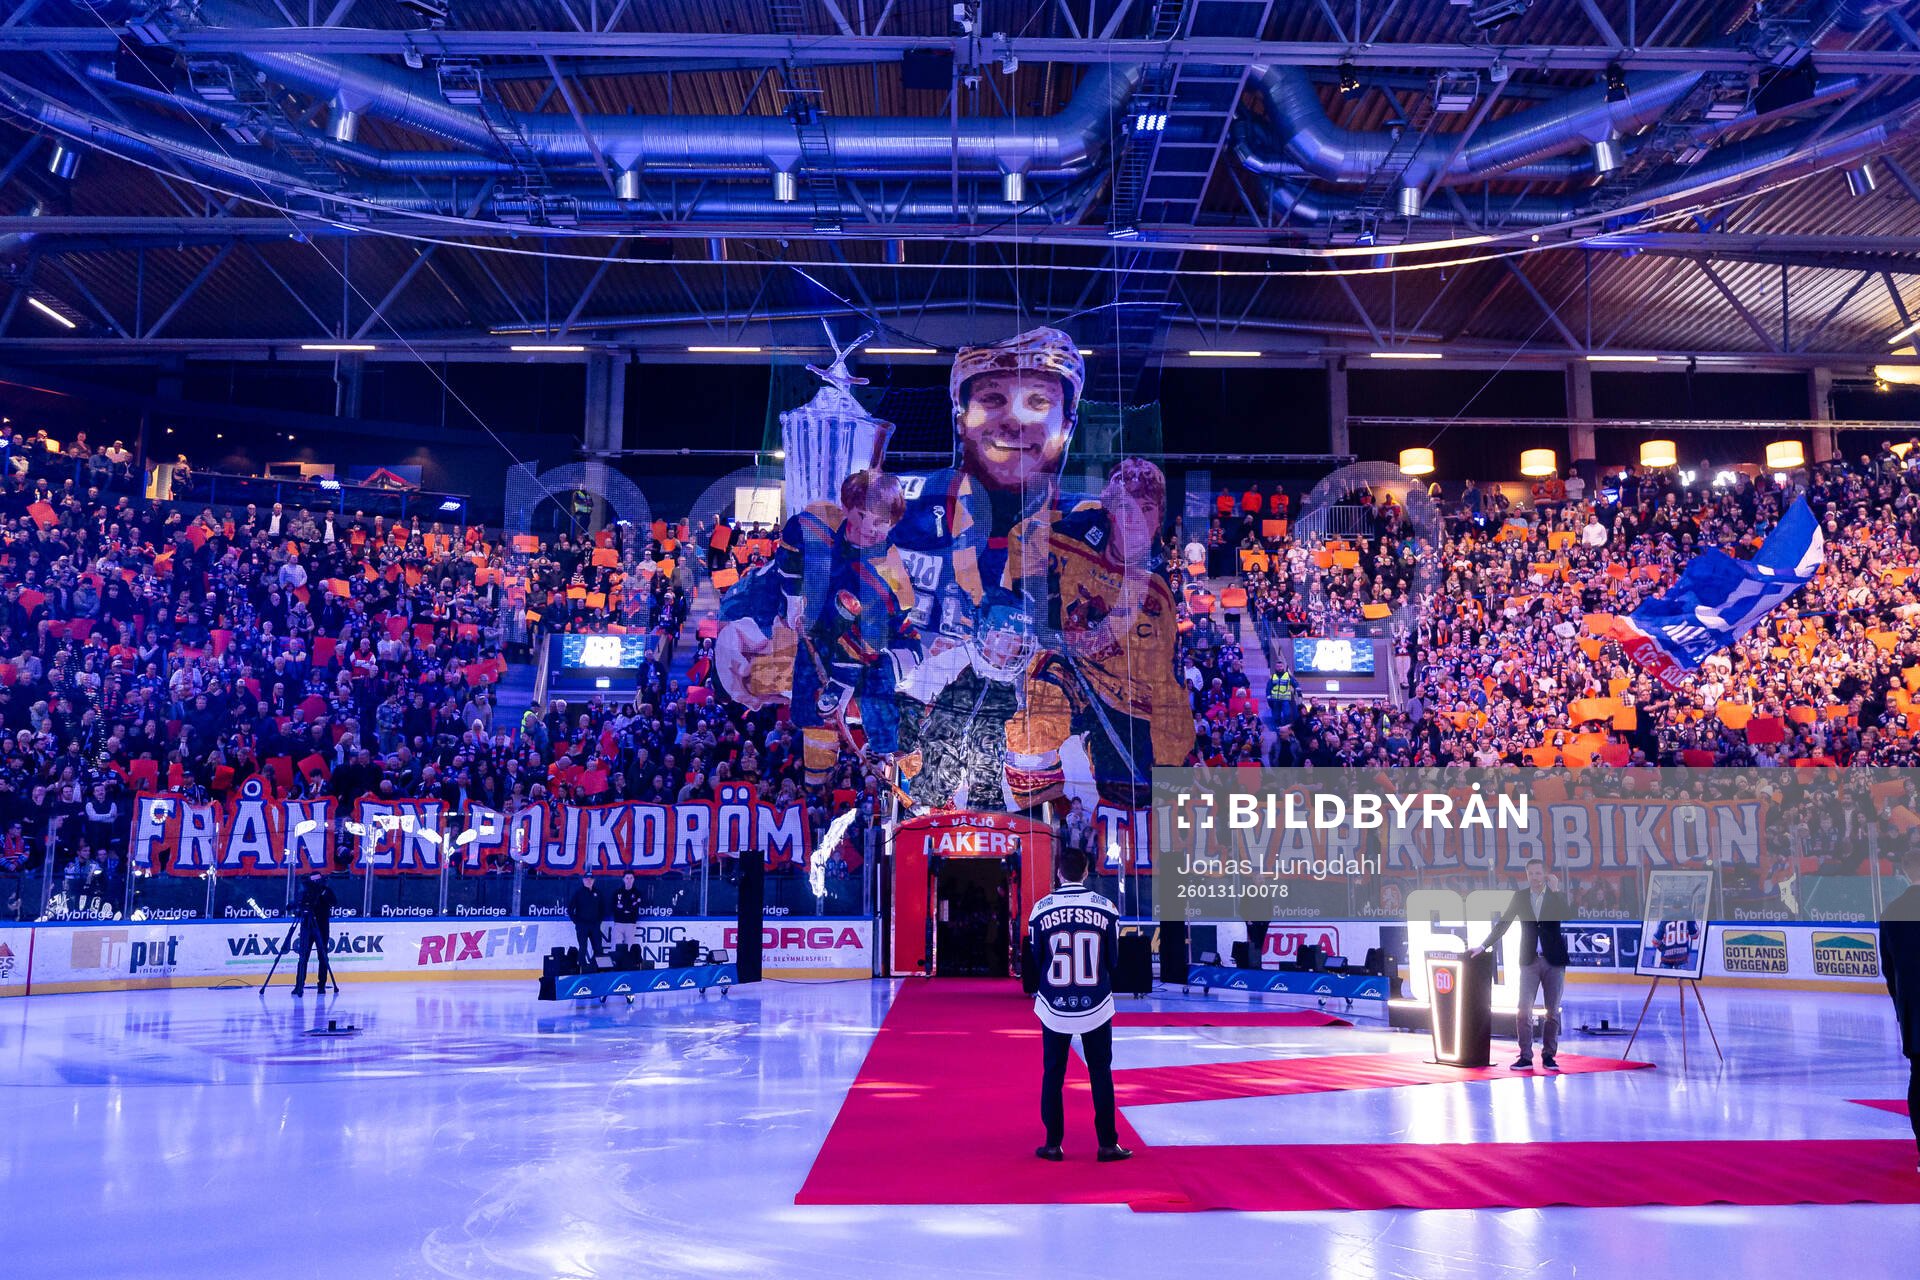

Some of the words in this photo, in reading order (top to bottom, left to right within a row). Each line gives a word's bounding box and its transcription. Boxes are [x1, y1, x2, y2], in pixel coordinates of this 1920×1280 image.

[134, 779, 331, 868] FRÅN
[356, 798, 444, 868] EN
[463, 784, 807, 870] POJKDRÖM
[1236, 787, 1362, 872] VÅR
[1385, 803, 1762, 872] KLUBBIKON
[952, 816, 995, 827] VÄXJÖ
[381, 904, 434, 917] Hybridge
[456, 904, 507, 916] Hybridge
[529, 904, 569, 916] Hybrid
[638, 905, 673, 916] bridge
[762, 905, 789, 916] ridge
[1273, 905, 1320, 917] Hybridge
[1578, 905, 1630, 919] Hybridge
[1734, 907, 1789, 920] Hybridge
[1811, 907, 1865, 922] Hybridge
[1040, 908, 1109, 931] JOSEFSSON
[600, 926, 686, 943] NRDIC
[1665, 920, 1688, 947] 60
[1047, 930, 1100, 987] 60
[1725, 946, 1786, 959] GOTLANDS
[1815, 949, 1876, 962] GOTLANDS
[1726, 959, 1770, 971] BYGGEN
[1771, 960, 1786, 971] AB
[1816, 962, 1861, 974] BYGGEN
[1862, 964, 1877, 975] AB
[1436, 972, 1451, 990] 60
